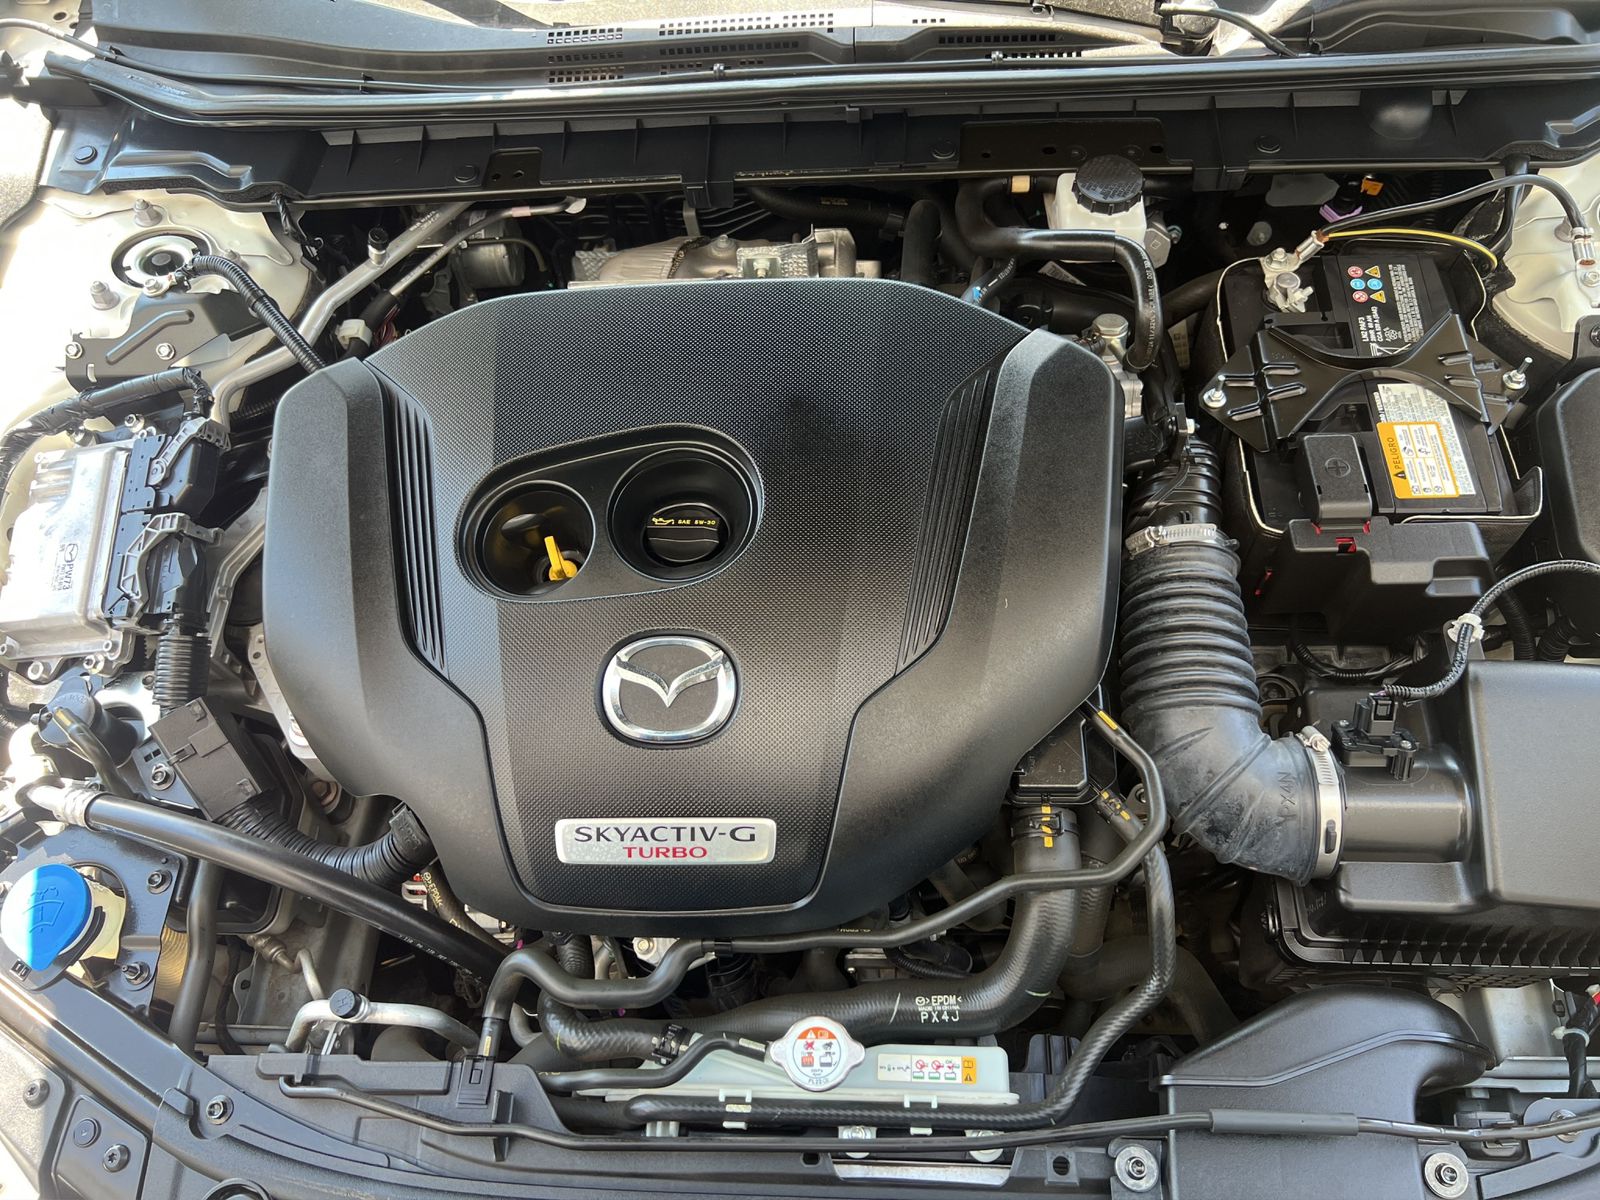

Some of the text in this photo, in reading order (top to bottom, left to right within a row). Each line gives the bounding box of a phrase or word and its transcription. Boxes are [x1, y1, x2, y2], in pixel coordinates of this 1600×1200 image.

[1387, 437, 1402, 470] PELIGRO
[63, 563, 74, 590] PW73
[574, 826, 756, 842] SKYACTIV-G
[622, 846, 708, 859] TURBO
[920, 1010, 960, 1023] PX4J
